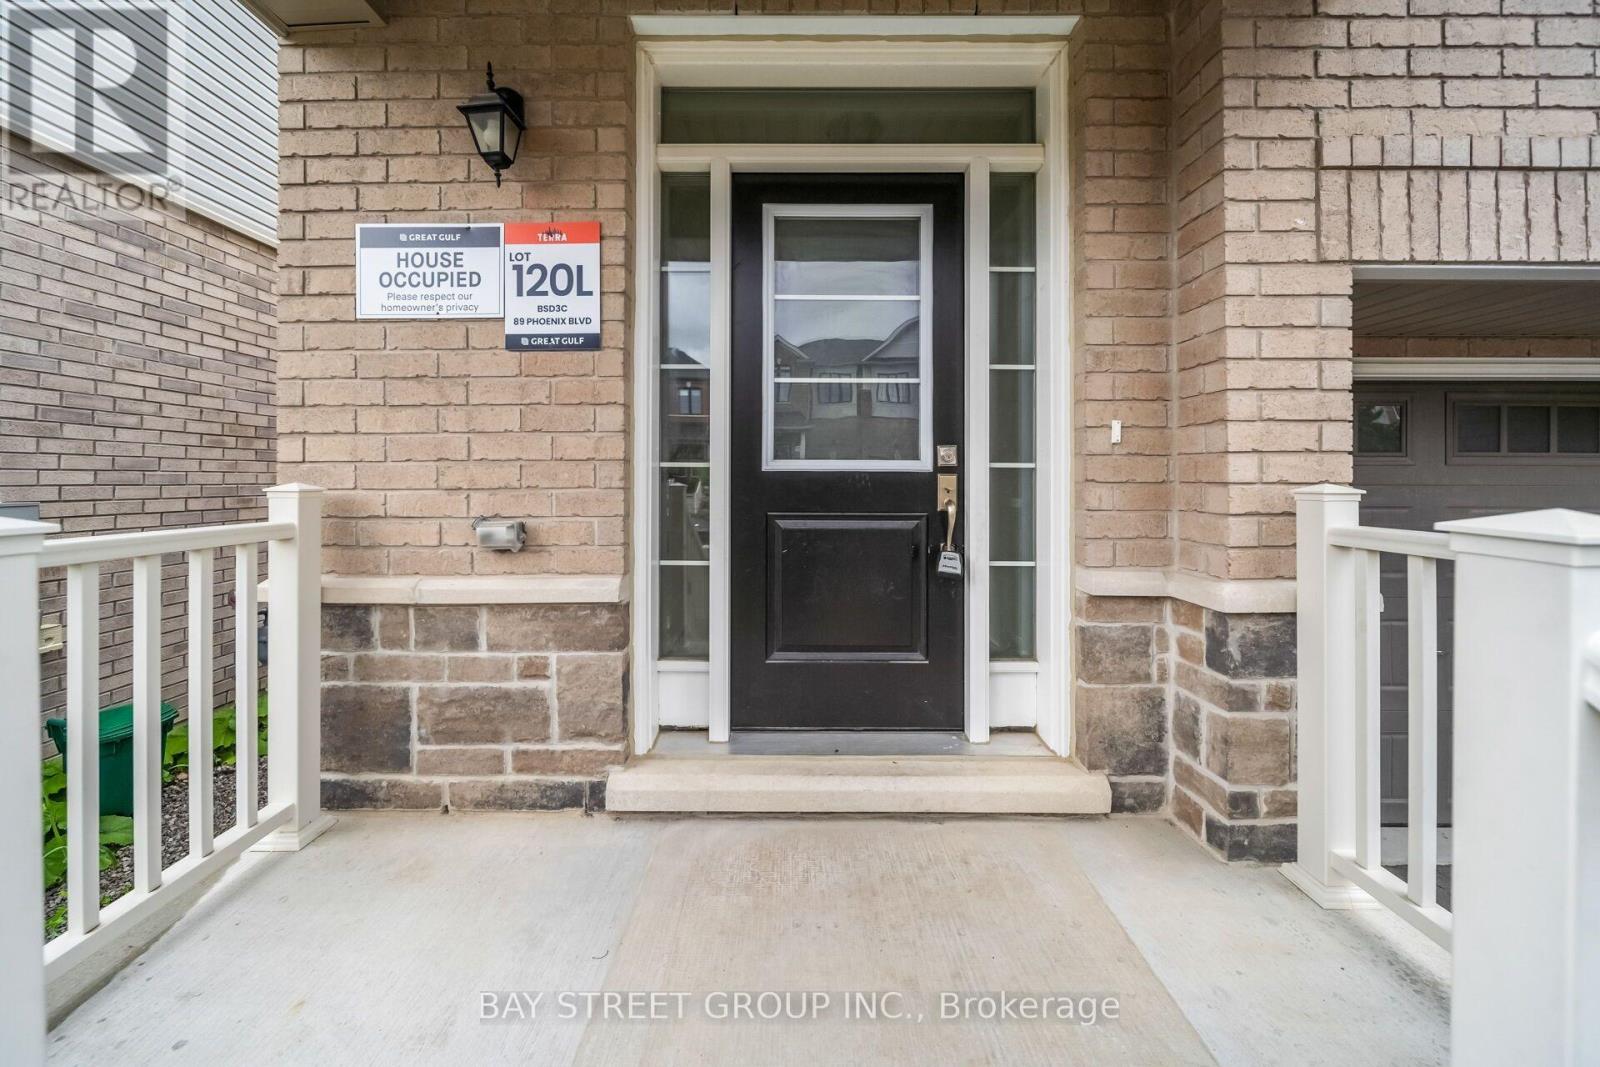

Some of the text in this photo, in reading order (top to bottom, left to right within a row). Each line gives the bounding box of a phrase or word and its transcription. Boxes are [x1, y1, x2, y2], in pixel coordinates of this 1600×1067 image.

[409, 233, 461, 241] GREAT GULF
[537, 233, 568, 242] TERRA
[396, 252, 464, 268] HOUSE
[509, 252, 531, 262] LOT
[379, 271, 482, 288] OCCUPIED
[512, 263, 594, 297] 120L
[387, 292, 473, 304] Please respect our
[381, 303, 479, 314] homeowner's privacy
[537, 304, 568, 313] BSD3C
[513, 316, 592, 326] 89 PHOENIX BLVD
[531, 337, 584, 345] GREAT GULF
